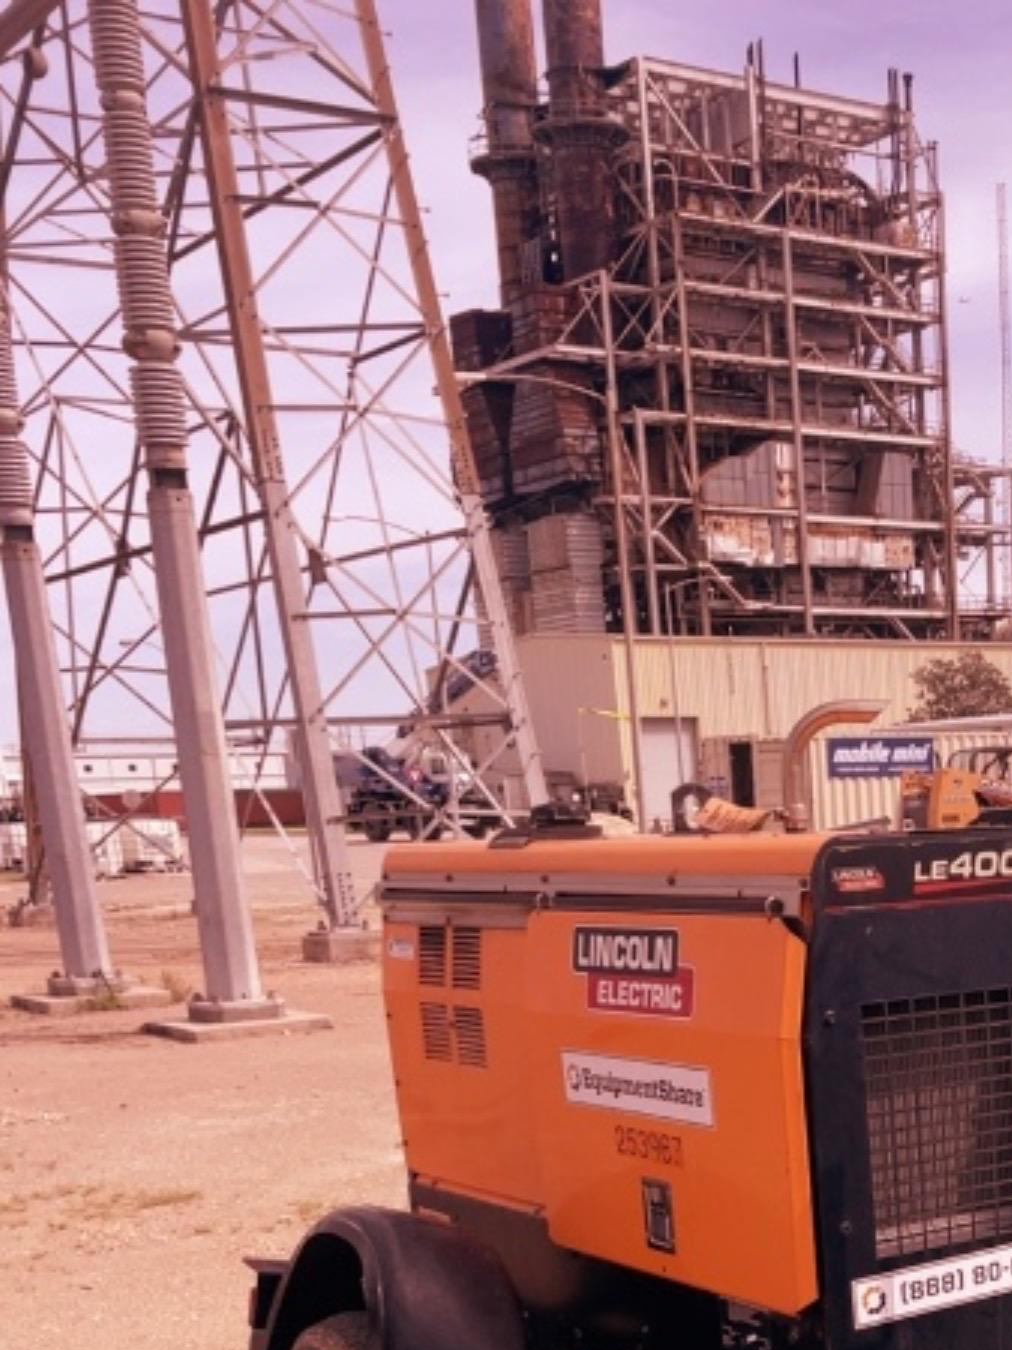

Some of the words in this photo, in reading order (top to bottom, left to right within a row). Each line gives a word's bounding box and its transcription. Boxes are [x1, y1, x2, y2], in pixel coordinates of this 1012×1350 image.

[578, 932, 673, 971] LINCOLN
[597, 979, 682, 1011] ELECTRIC
[582, 1067, 704, 1107] EquipmentShare
[900, 1269, 964, 1304] (888)
